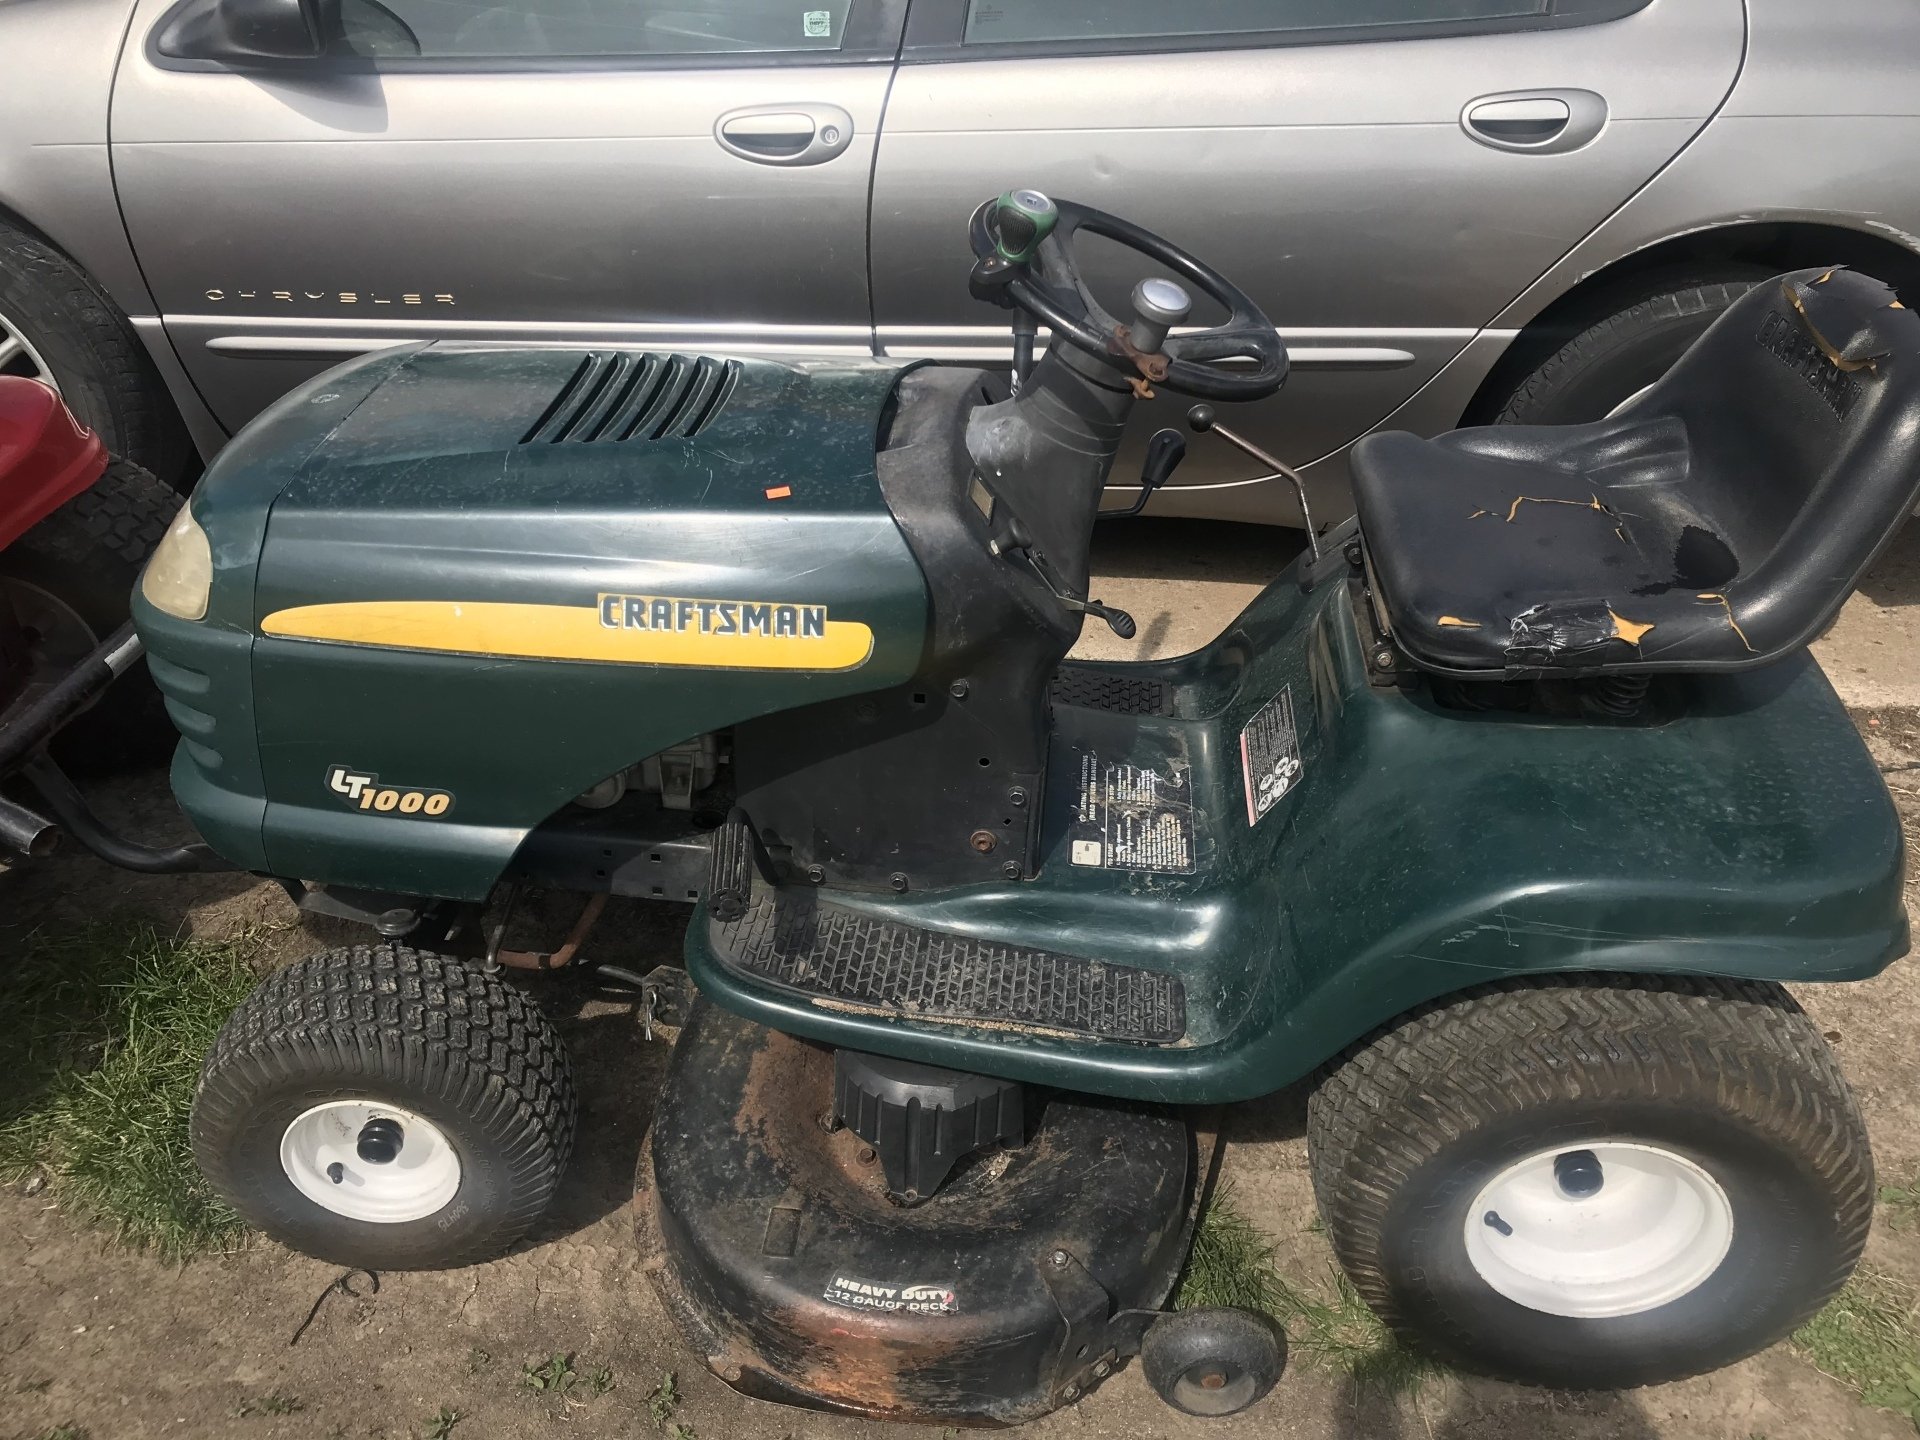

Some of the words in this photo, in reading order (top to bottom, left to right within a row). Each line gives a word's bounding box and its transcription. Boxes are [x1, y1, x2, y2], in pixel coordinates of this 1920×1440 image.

[205, 289, 455, 305] CHRYSLER
[599, 594, 825, 639] CRAFTSMAN
[330, 769, 371, 799] LT
[359, 788, 450, 815] 1000
[835, 1277, 897, 1298] HEAVY
[902, 1288, 952, 1301] DUTY
[908, 1302, 950, 1313] DECK
